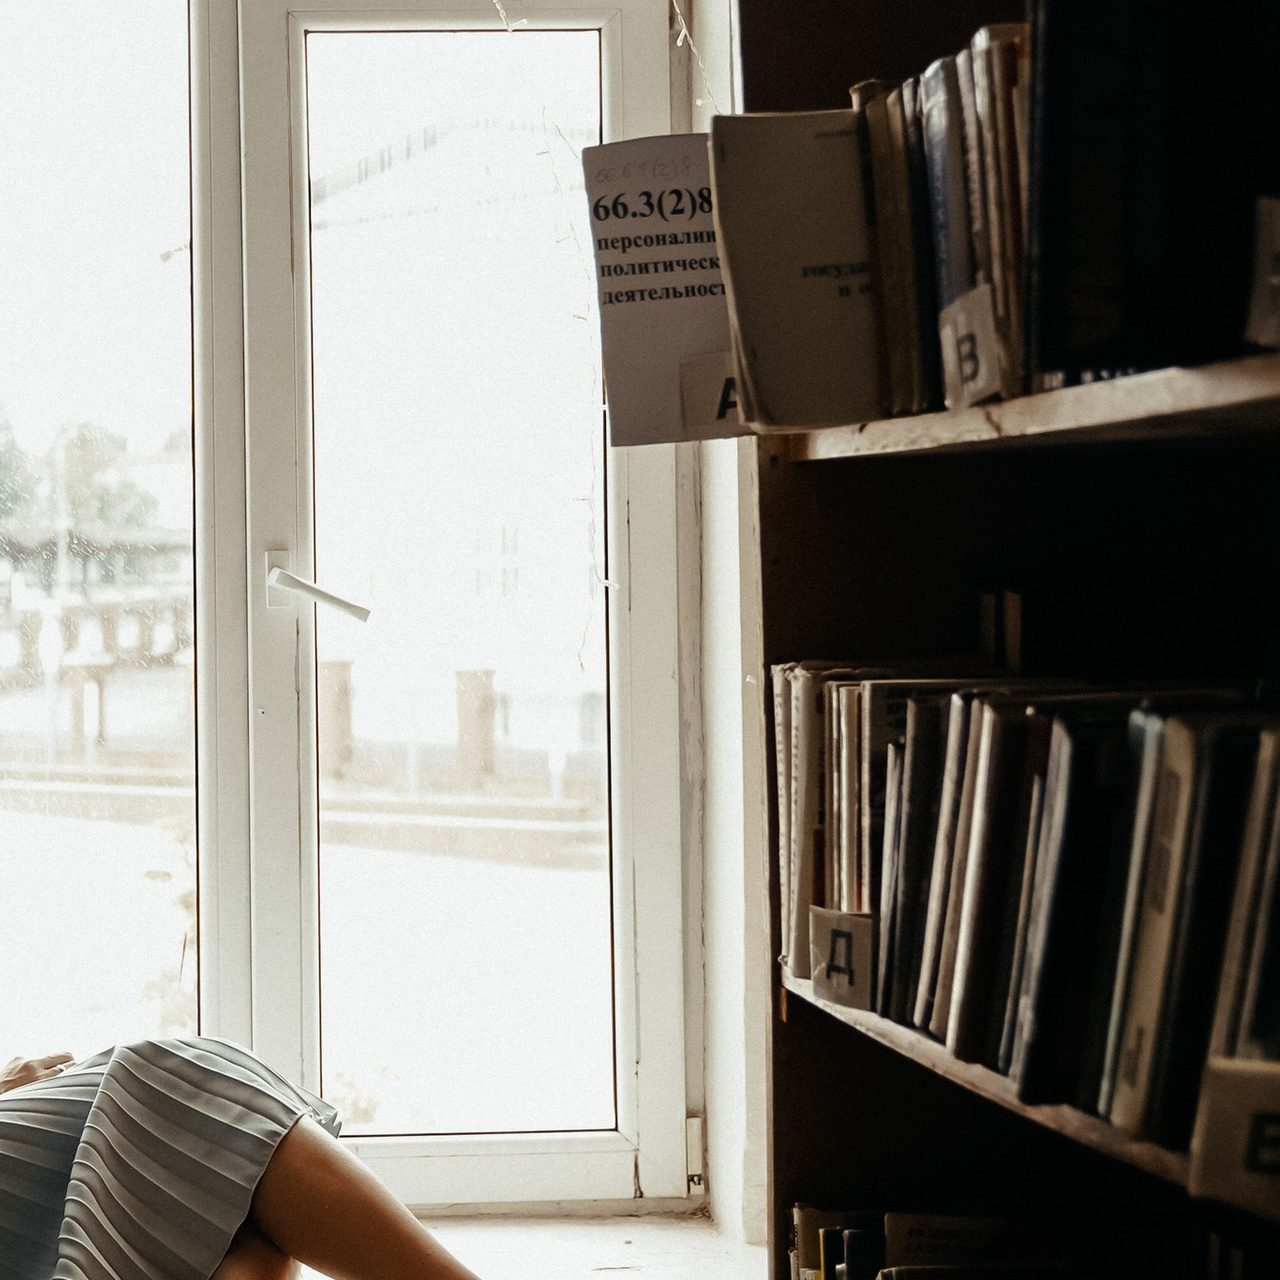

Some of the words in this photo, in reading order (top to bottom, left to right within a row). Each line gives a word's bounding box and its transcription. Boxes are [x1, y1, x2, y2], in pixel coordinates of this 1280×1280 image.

[593, 186, 713, 222] 66.3(2)8
[600, 256, 720, 278] политическ
[956, 333, 980, 384] В
[716, 376, 738, 420] А
[825, 927, 856, 987] Д
